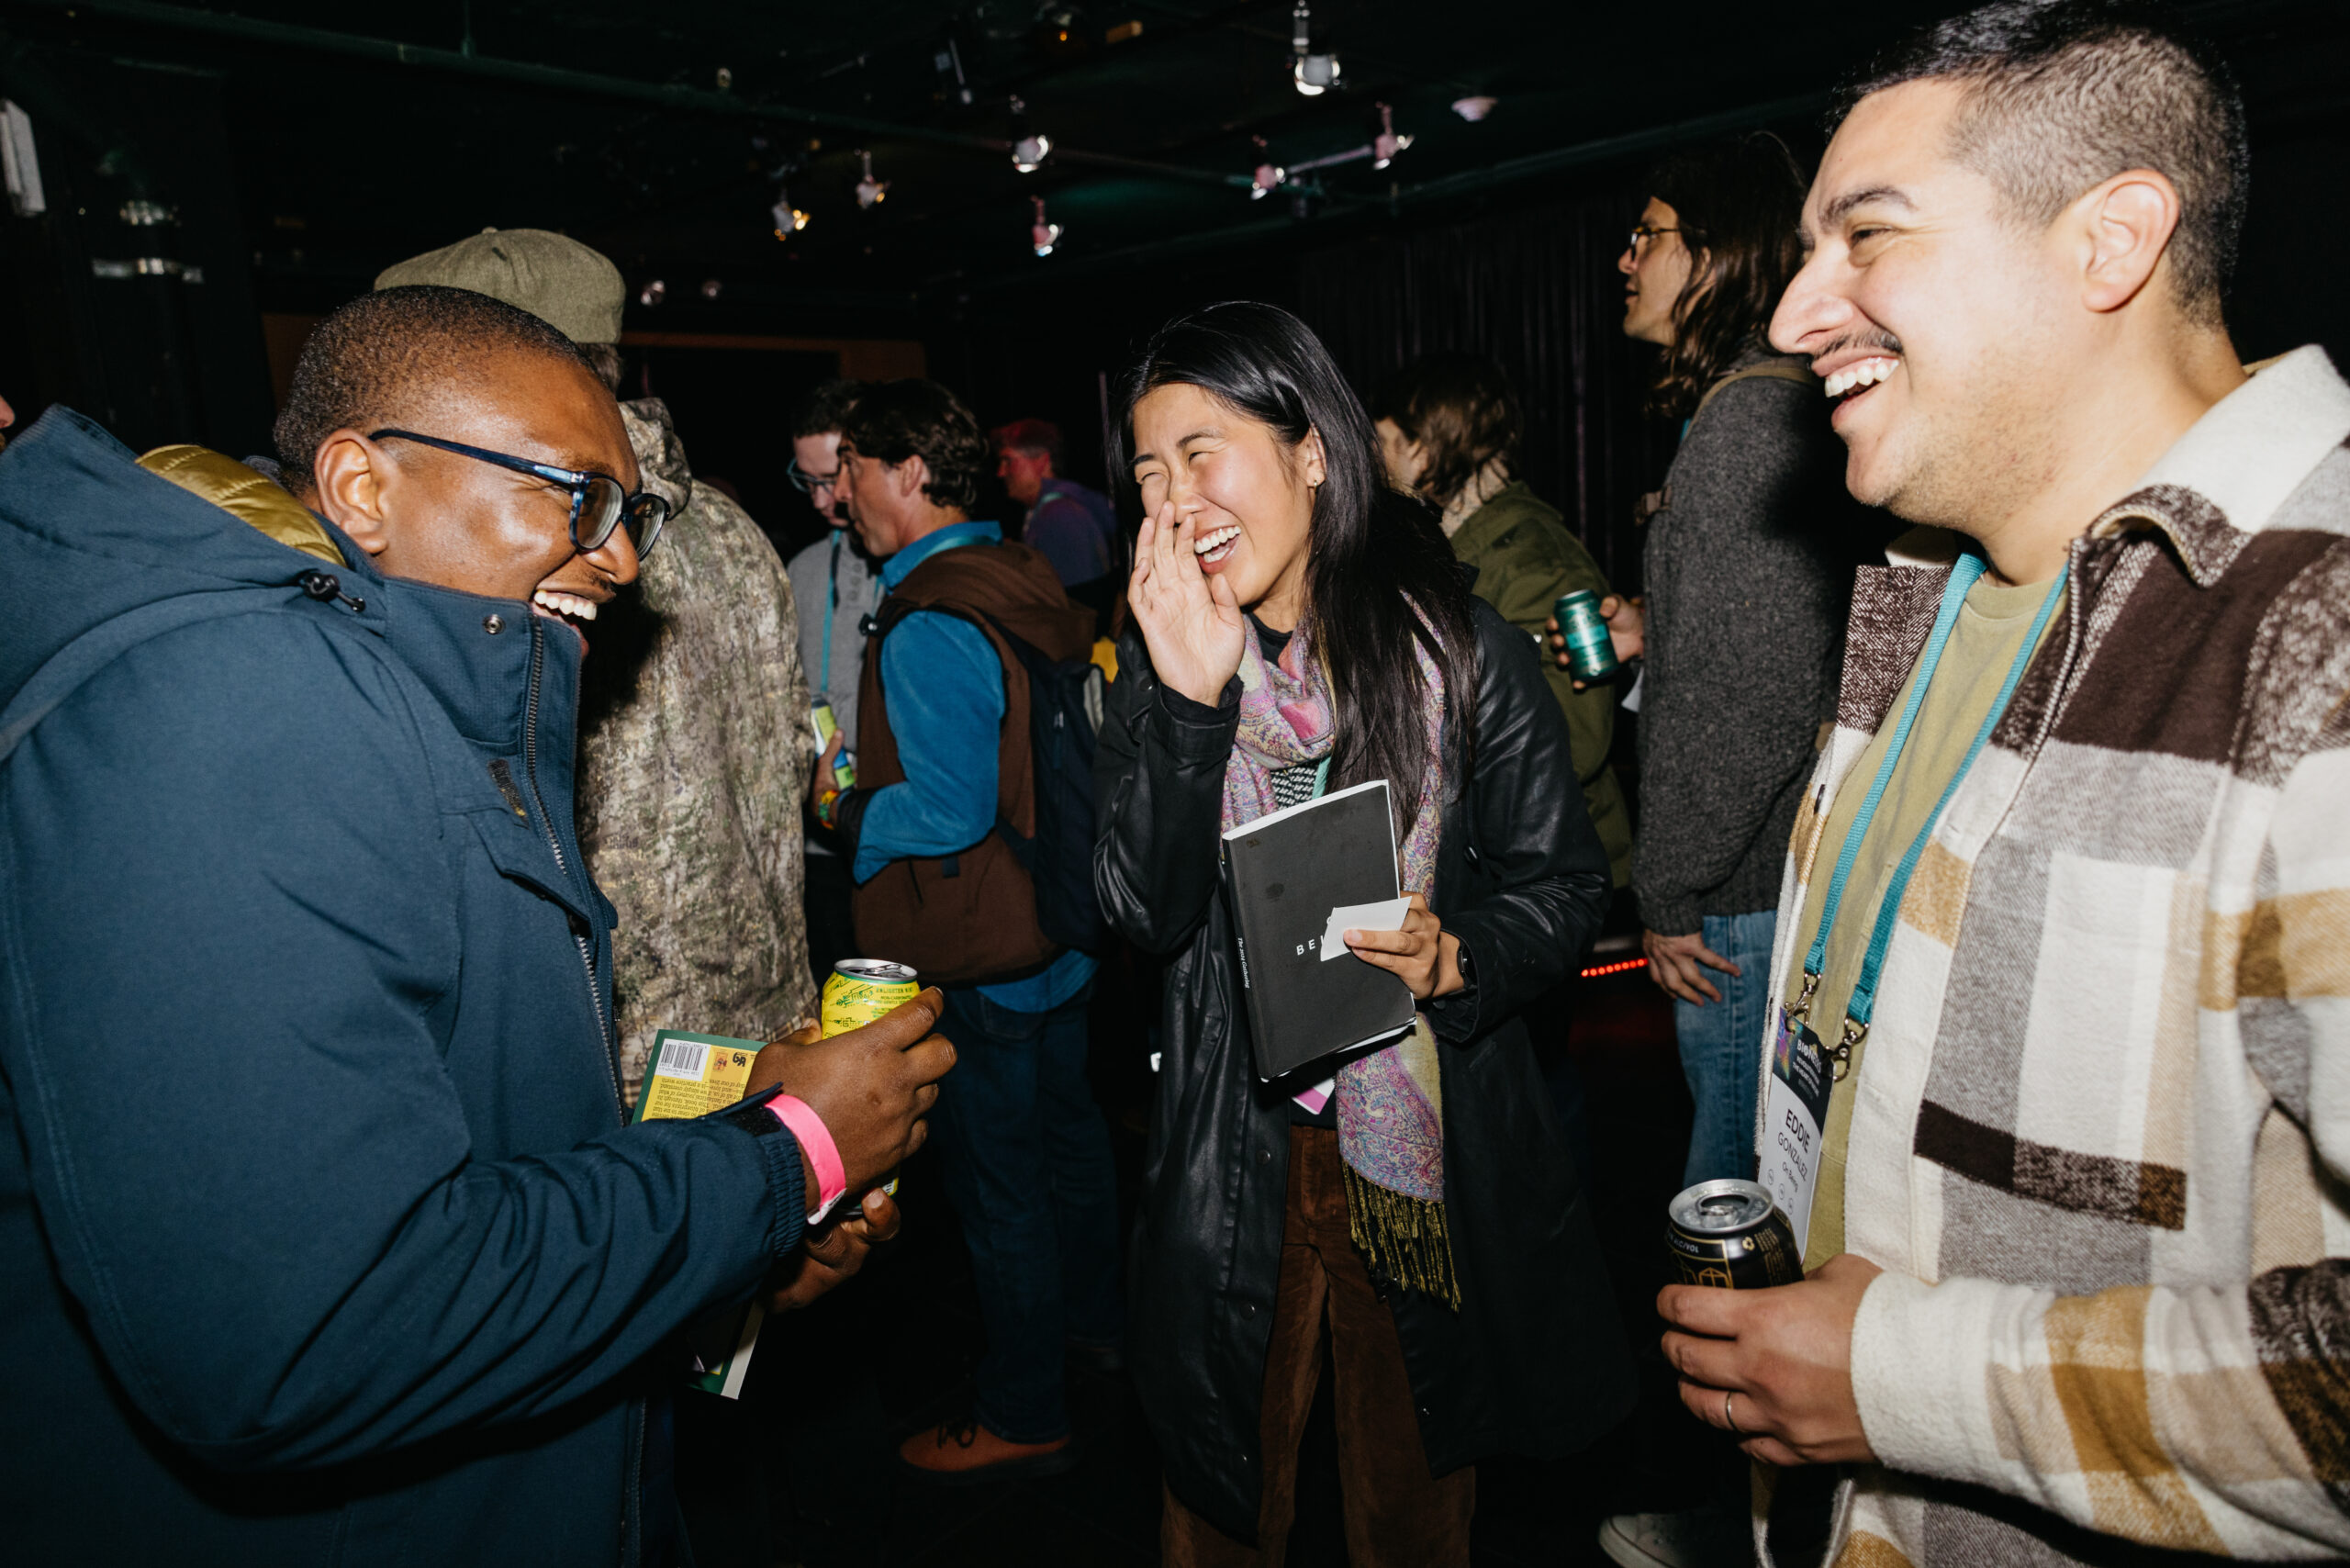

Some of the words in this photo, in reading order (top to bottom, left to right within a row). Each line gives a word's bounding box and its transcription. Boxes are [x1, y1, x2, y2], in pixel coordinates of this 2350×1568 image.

[1241, 961, 1250, 989] Gathering
[1785, 1108, 1810, 1154] EDDIE
[1778, 1131, 1807, 1182] GONZALEZ
